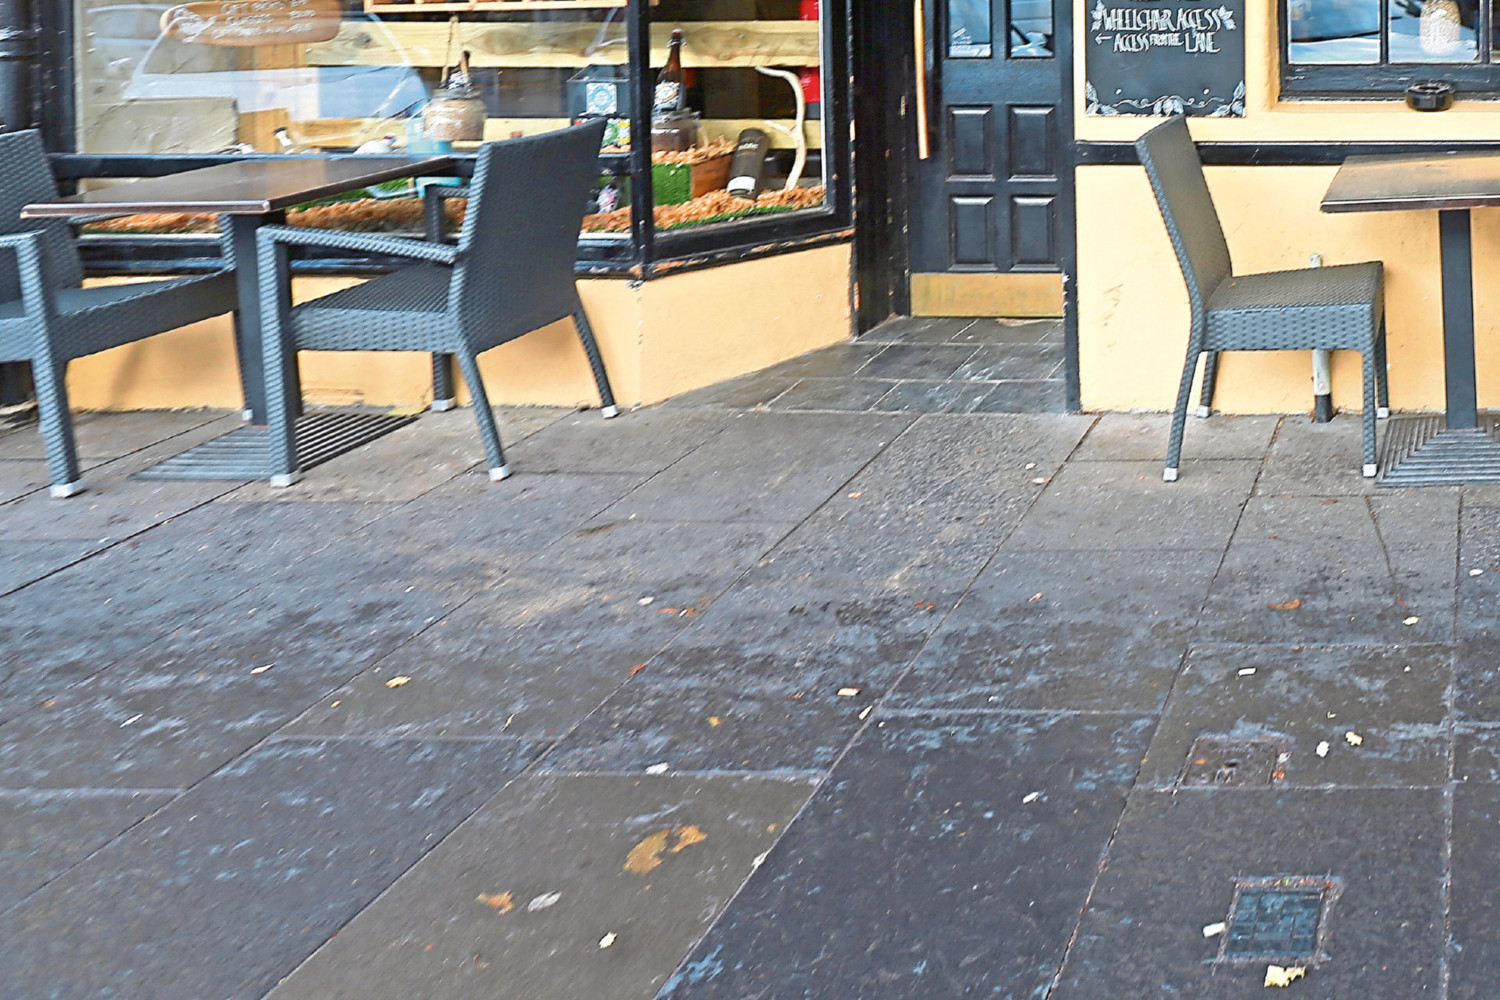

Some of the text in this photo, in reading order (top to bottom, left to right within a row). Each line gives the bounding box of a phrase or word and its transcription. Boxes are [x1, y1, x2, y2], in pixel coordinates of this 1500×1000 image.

[1103, 7, 1221, 31] WHEELCHAIR ACCESS
[1113, 32, 1150, 53] ACCESS
